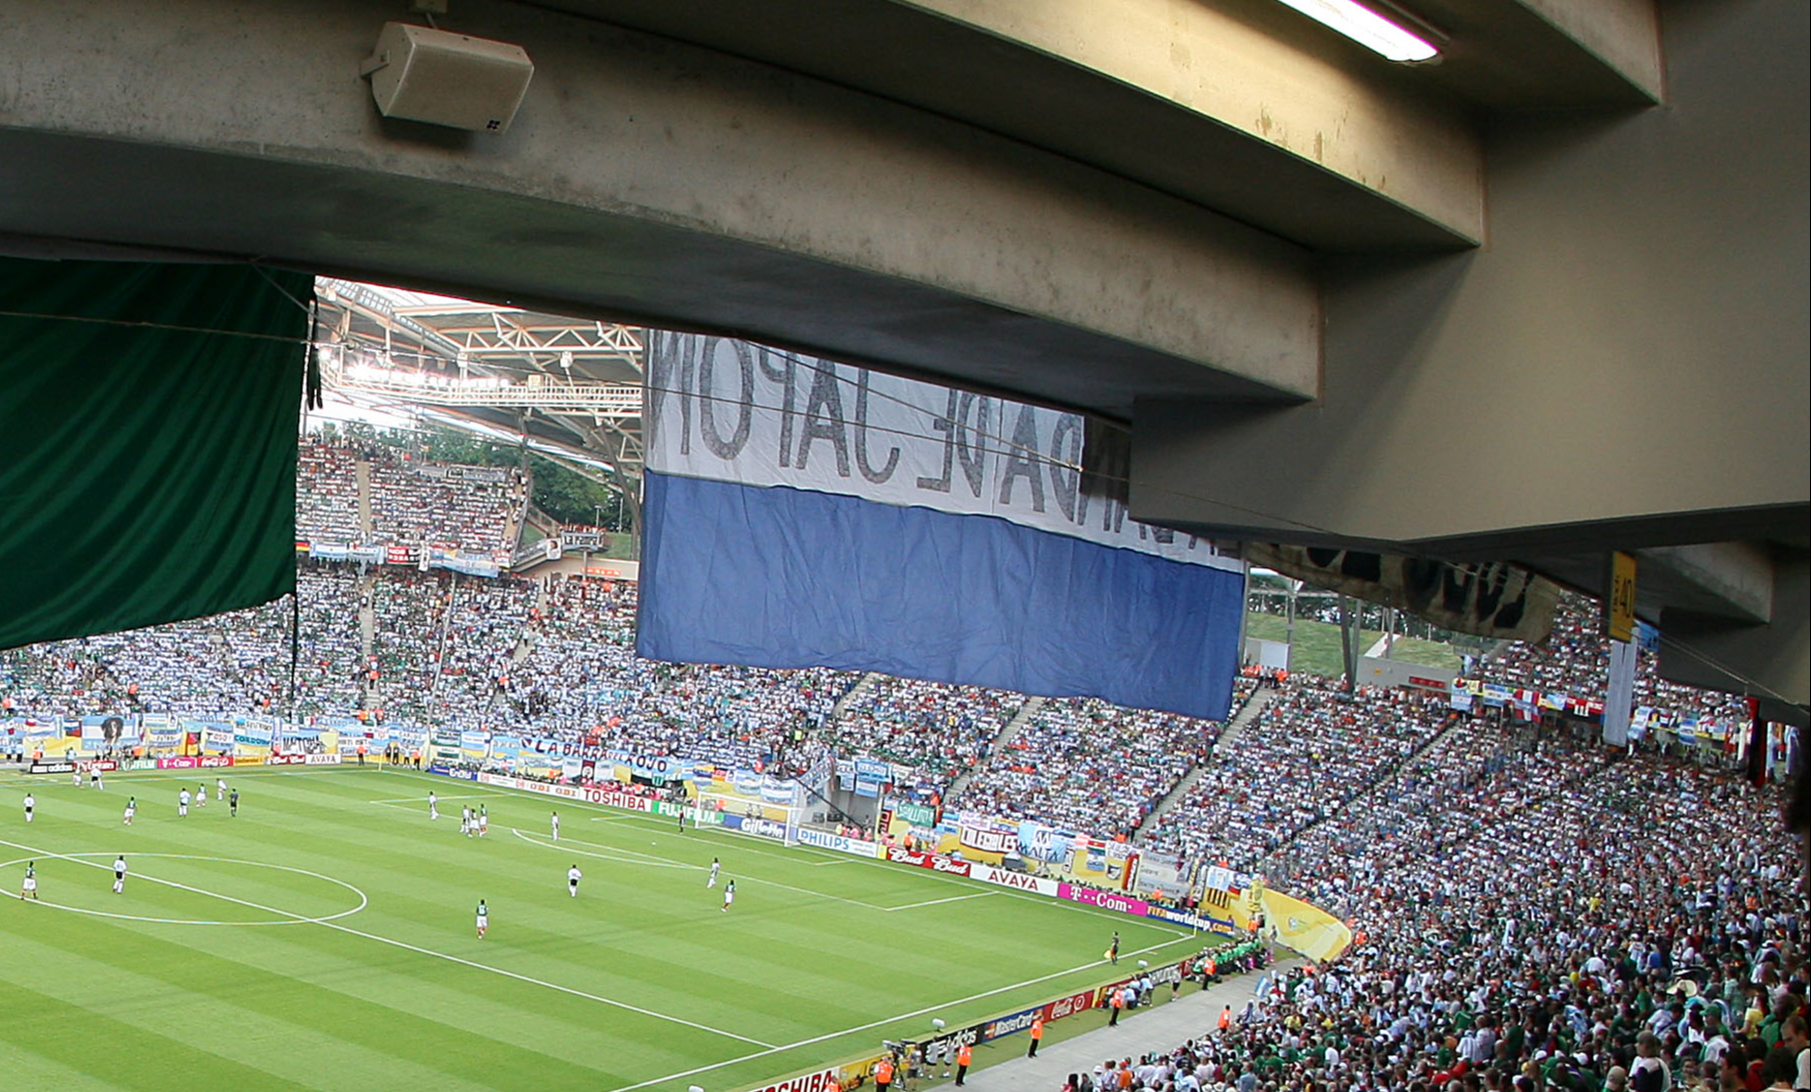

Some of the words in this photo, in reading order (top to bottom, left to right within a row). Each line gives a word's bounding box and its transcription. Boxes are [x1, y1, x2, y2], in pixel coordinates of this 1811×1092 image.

[310, 755, 336, 764] AVAYA
[535, 738, 558, 754] LA
[562, 743, 608, 760] BARRA
[530, 782, 551, 793] OBI
[555, 787, 576, 797] OBI
[584, 789, 646, 811] TOSHIBA
[740, 818, 785, 840] Gillette
[800, 830, 850, 851] PHILIPS
[888, 847, 926, 865] Bud
[931, 856, 970, 875] Bud
[987, 870, 1039, 891] AVAYA
[994, 1010, 1034, 1037] MasterCard
